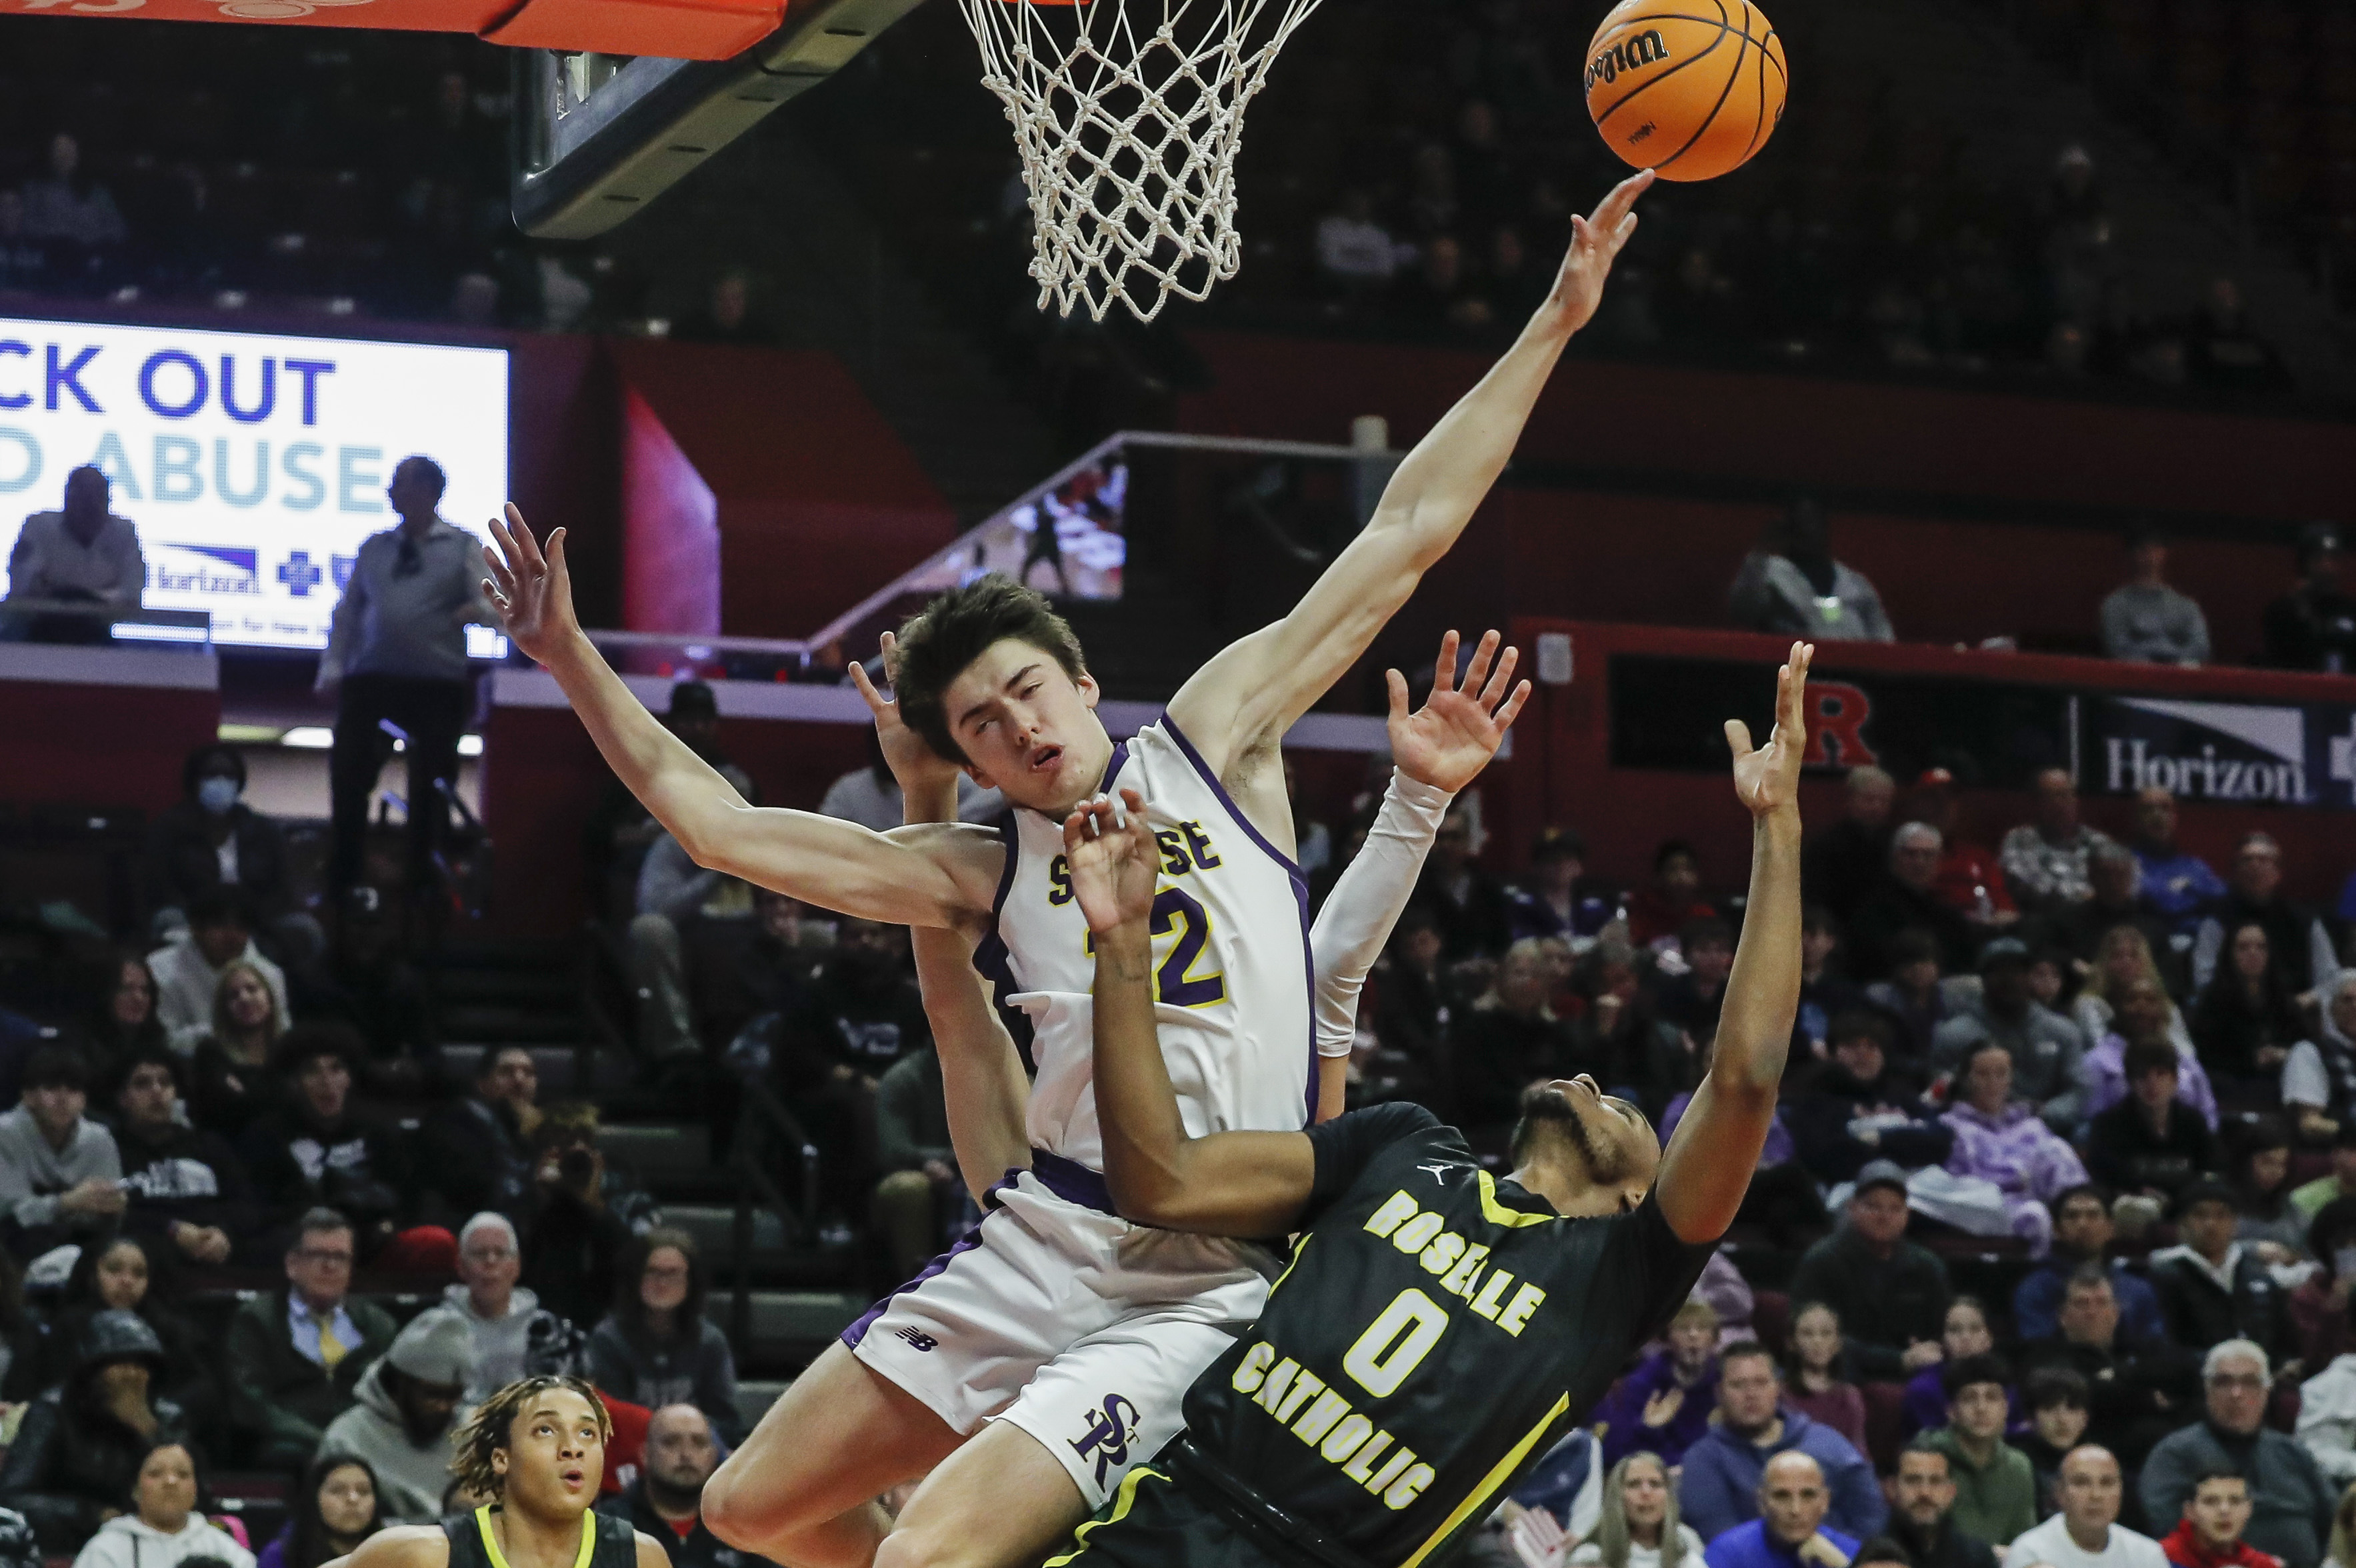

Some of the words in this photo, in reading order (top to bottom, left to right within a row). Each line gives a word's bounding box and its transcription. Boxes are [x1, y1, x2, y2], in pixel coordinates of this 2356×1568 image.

[138, 348, 336, 427] OUT
[92, 430, 385, 513] ABUSE
[2106, 736, 2308, 805] Horizon
[1342, 1287, 1449, 1399] 0
[1231, 1341, 1435, 1511] CATHOLIC
